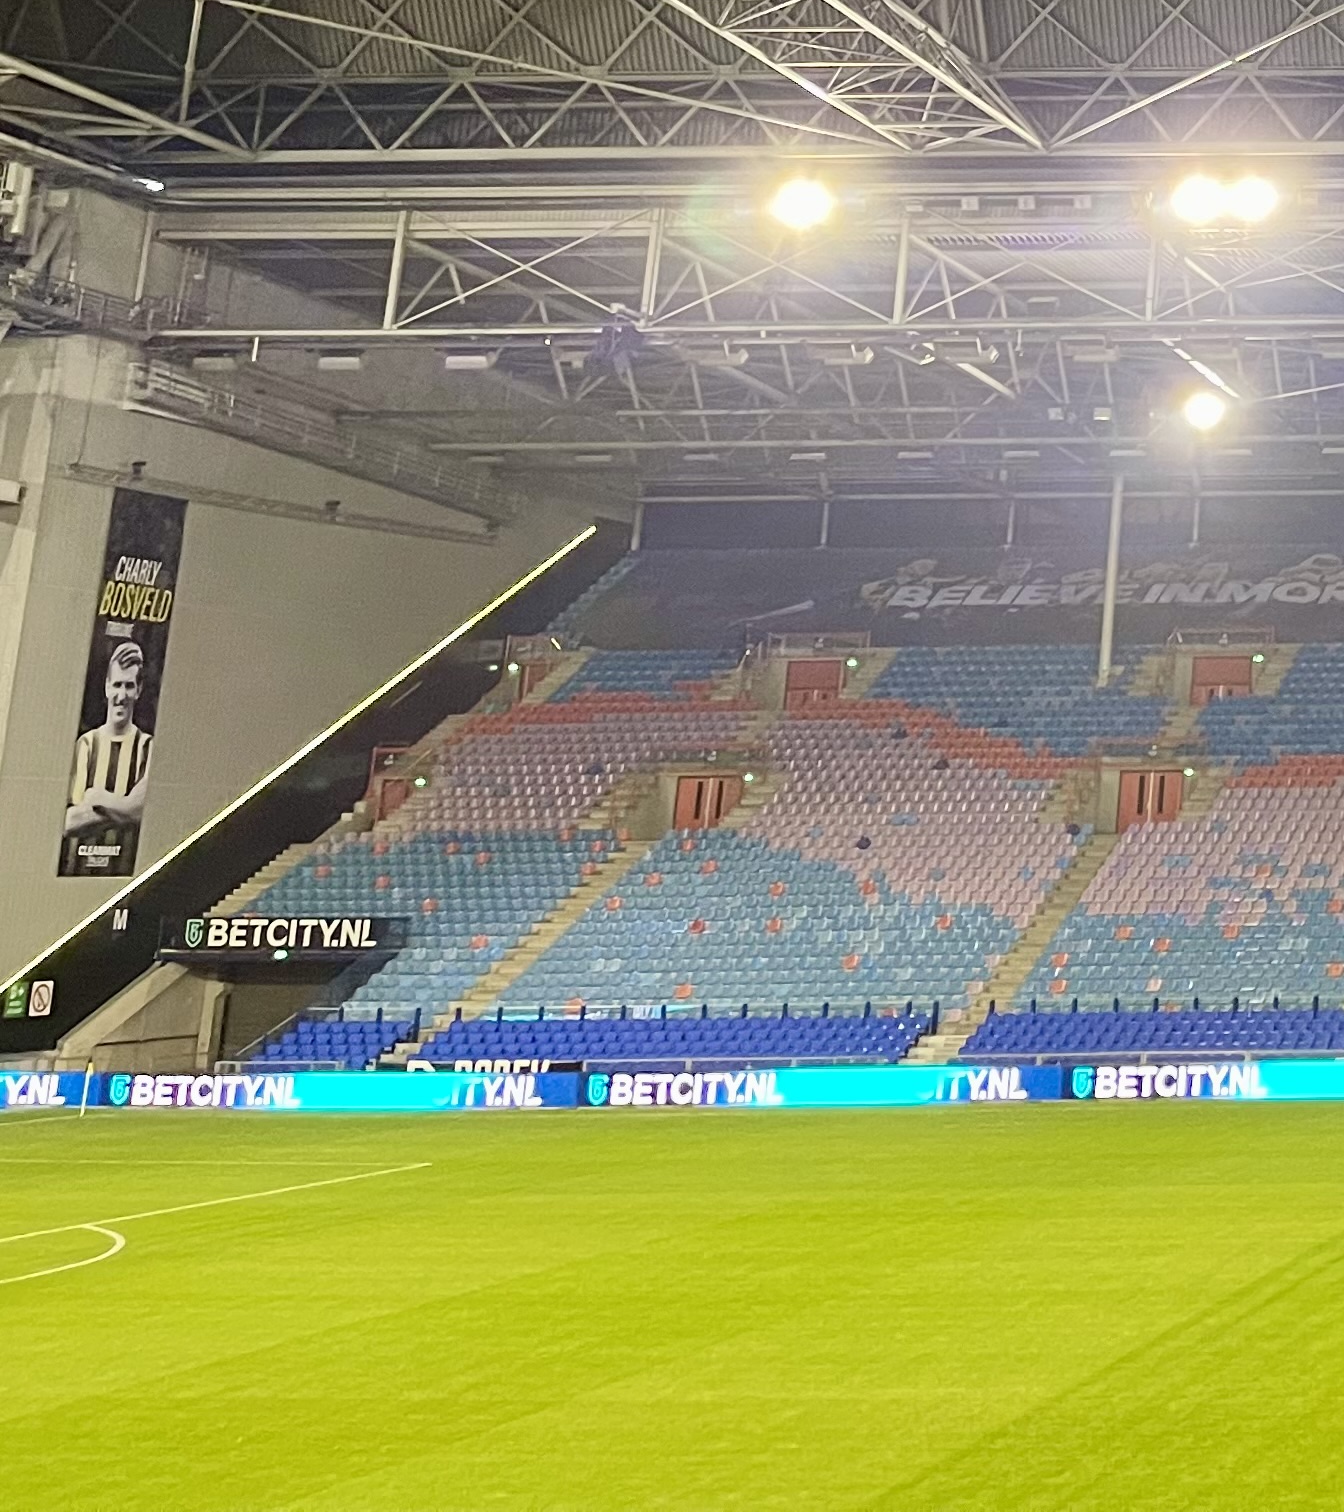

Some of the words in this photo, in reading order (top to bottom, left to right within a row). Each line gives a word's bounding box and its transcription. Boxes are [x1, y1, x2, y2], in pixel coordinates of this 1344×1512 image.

[115, 556, 162, 586] CHARLY
[98, 581, 172, 622] BOSVELD
[887, 584, 1141, 607] BELIEVE
[113, 909, 129, 930] M
[207, 918, 378, 947] BETCITY.NL
[0, 1074, 66, 1105] Y.NL
[130, 1074, 301, 1106] BETCITY.NL
[610, 1073, 783, 1106] BETCITY.NL
[1095, 1065, 1268, 1099] BETCITY.NL
